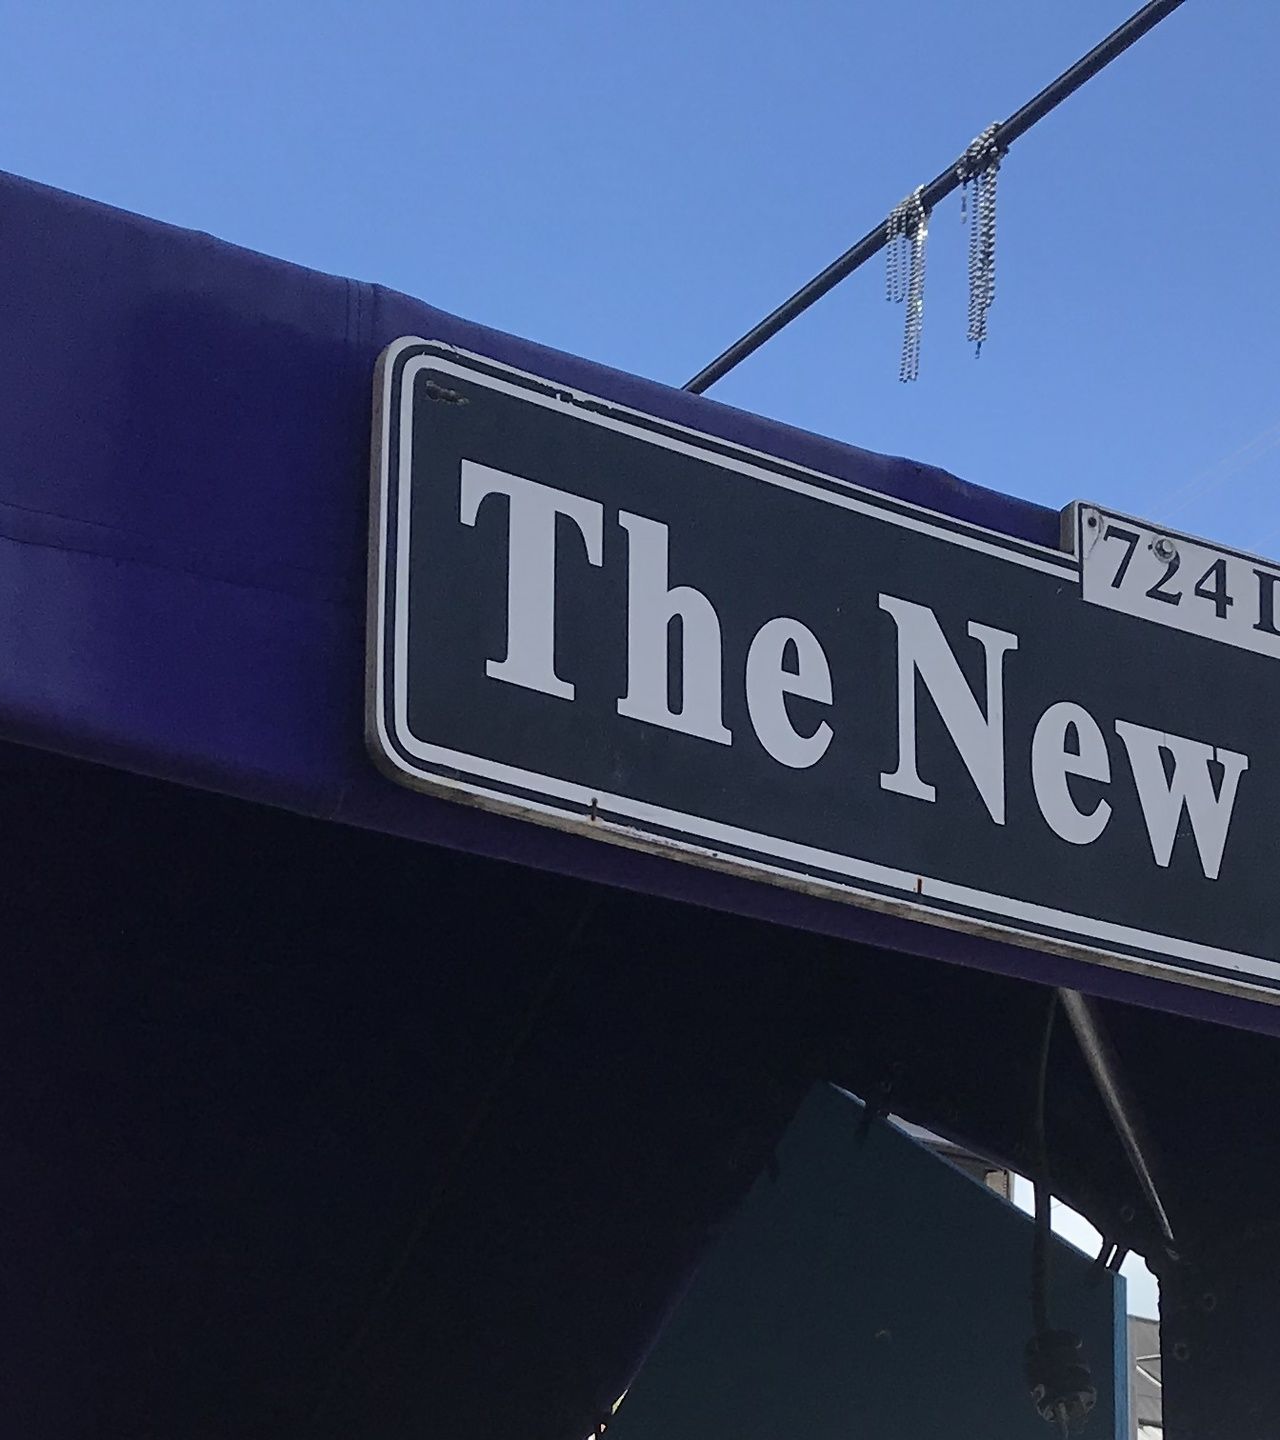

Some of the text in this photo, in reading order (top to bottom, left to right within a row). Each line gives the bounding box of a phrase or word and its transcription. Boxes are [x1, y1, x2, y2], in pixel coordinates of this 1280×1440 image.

[460, 458, 835, 769] The
[878, 592, 1250, 880] New
[1102, 526, 1234, 618] 724
